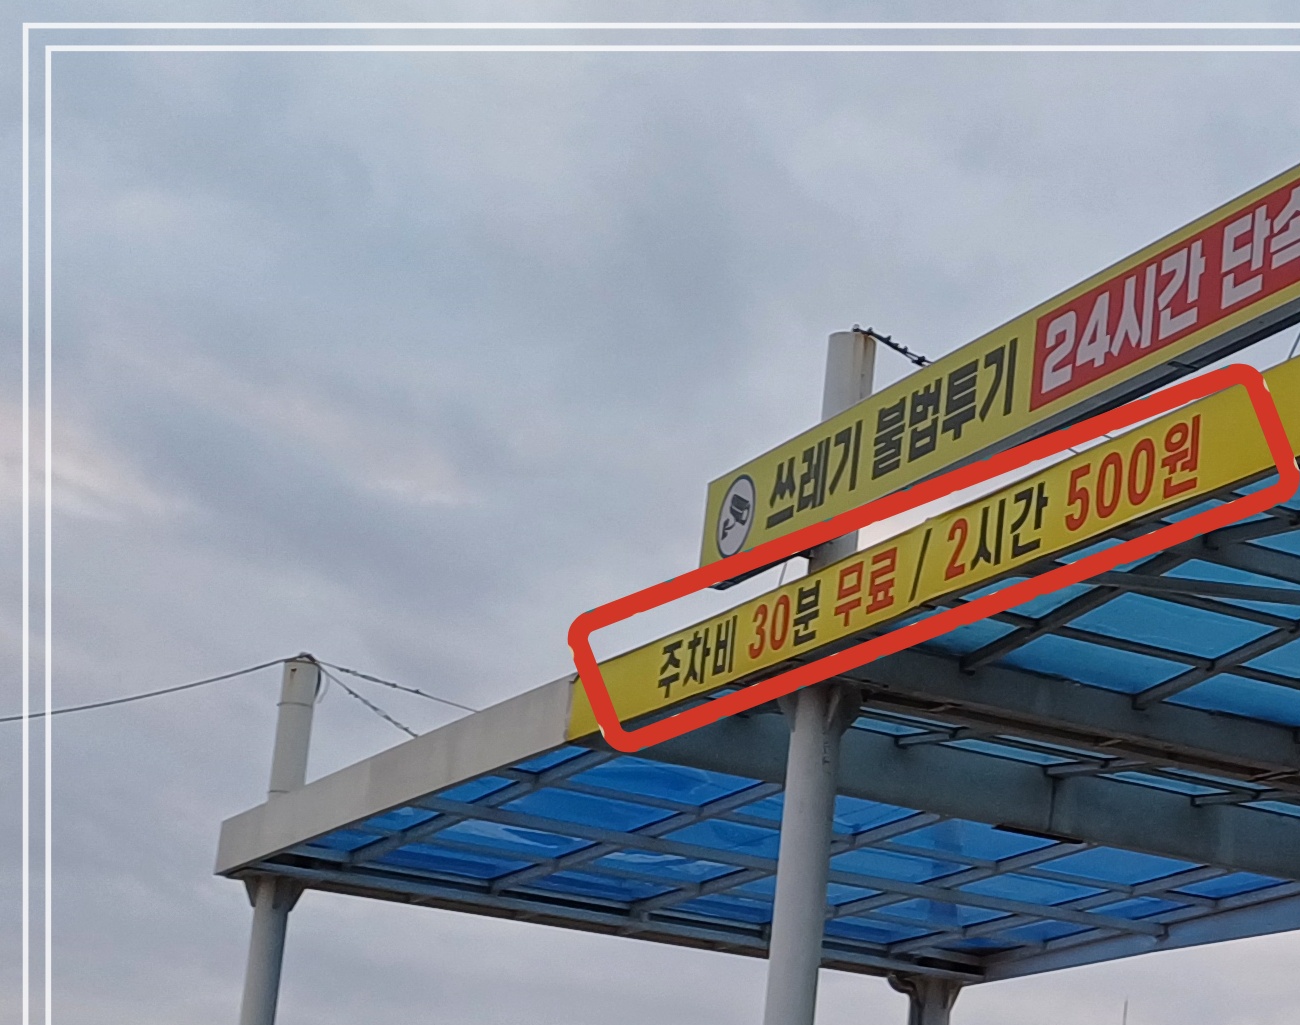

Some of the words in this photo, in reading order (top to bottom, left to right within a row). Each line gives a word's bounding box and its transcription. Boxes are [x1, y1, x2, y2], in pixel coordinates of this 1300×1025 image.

[765, 419, 863, 530] 쓰레기
[871, 337, 1018, 480] 불법투기
[1040, 238, 1205, 394] 24시간
[658, 614, 738, 698] 주차비
[748, 579, 821, 660] 30분
[834, 547, 898, 627] 무료
[944, 481, 1048, 581] 2시간
[1065, 414, 1201, 532] 500원
